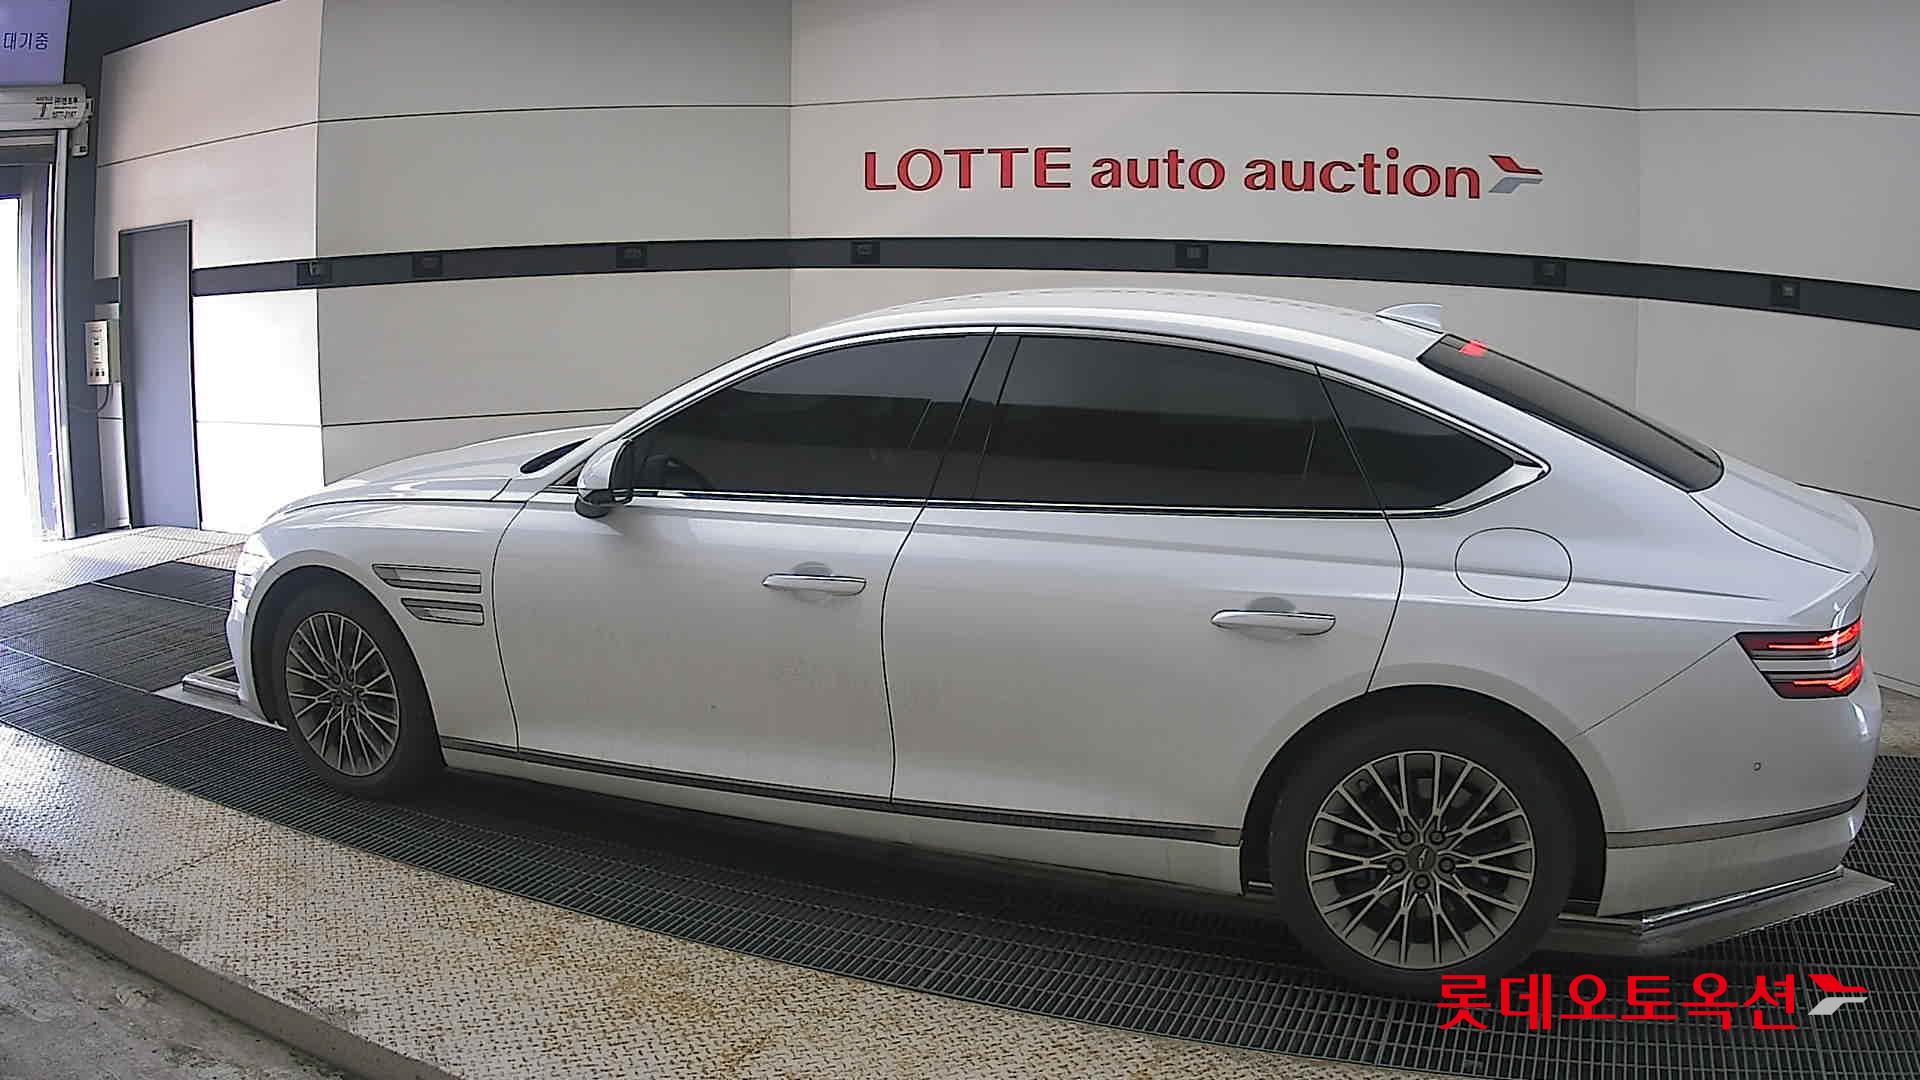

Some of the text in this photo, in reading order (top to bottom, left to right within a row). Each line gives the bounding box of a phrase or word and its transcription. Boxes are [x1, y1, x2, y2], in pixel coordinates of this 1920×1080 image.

[3, 32, 49, 50] 대기중
[864, 147, 1481, 199] LOTTE auto auction
